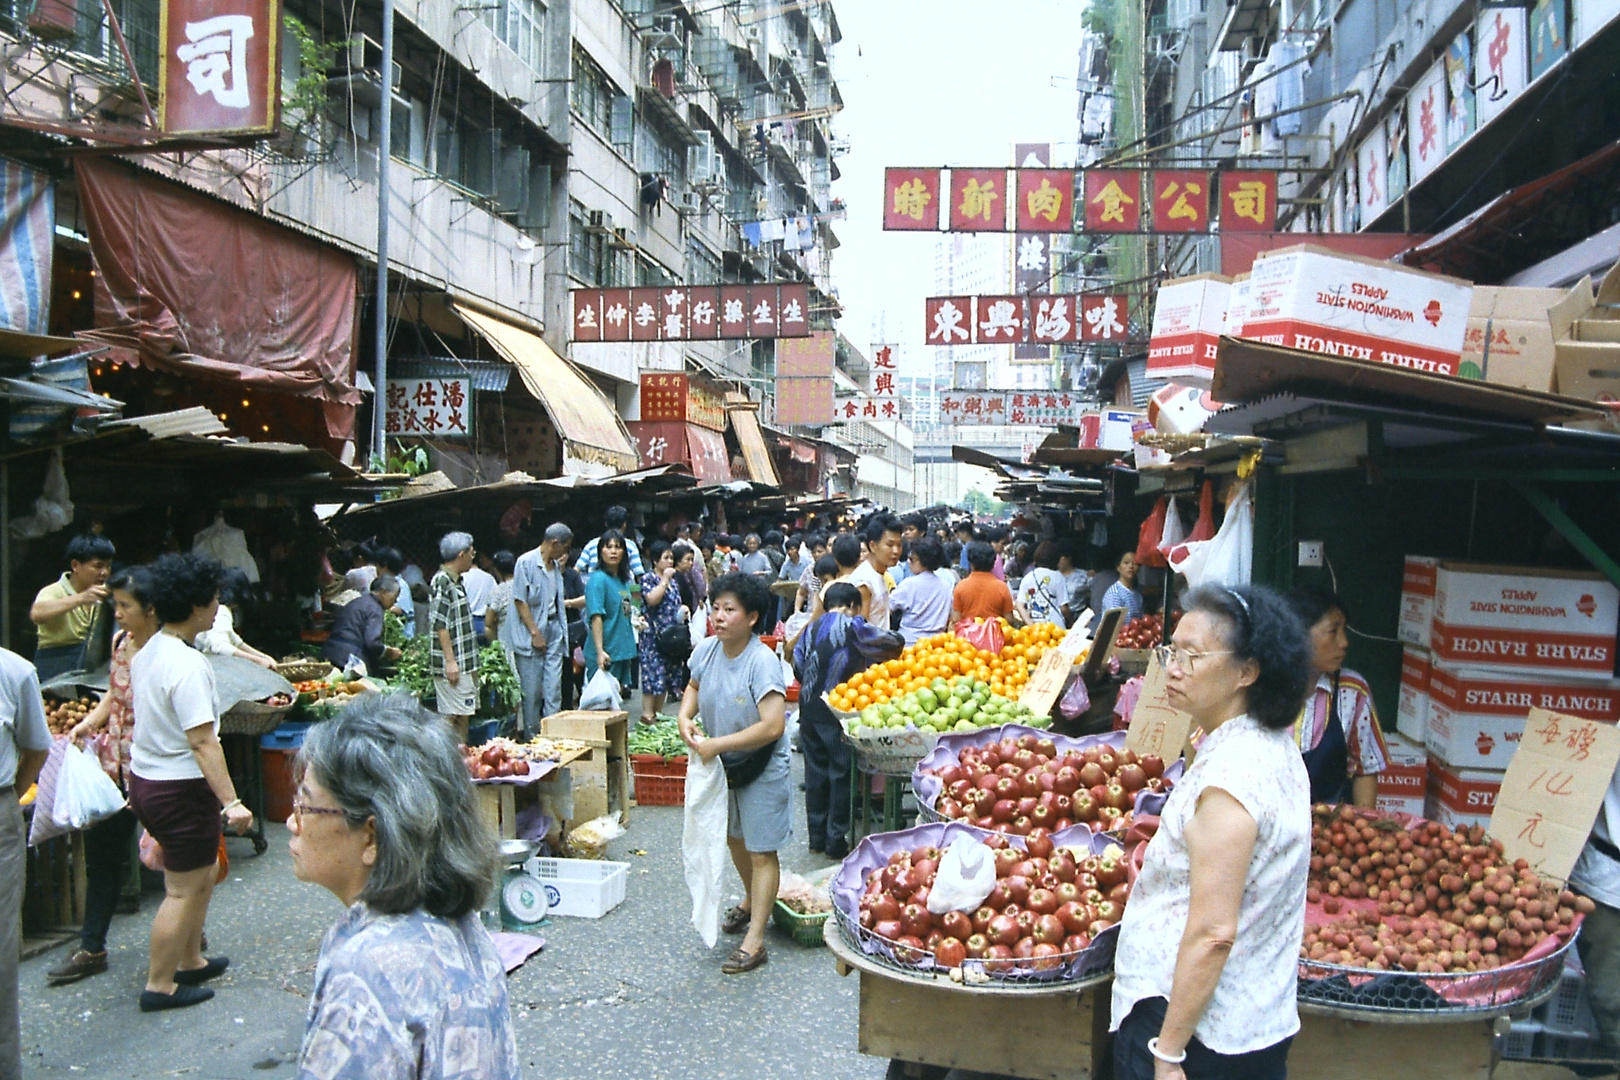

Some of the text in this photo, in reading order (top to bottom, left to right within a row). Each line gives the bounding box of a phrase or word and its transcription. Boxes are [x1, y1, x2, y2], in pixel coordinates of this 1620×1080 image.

[176, 14, 255, 108] 司
[893, 176, 1267, 225] 時新肉食公司
[1351, 282, 1389, 300] APPLES
[929, 297, 1125, 342] 東興海味
[1347, 297, 1416, 324] WASHINGTON
[874, 345, 897, 395] 建興
[1501, 588, 1538, 601] APPLES
[1469, 600, 1567, 618] WASHINGTON STATE
[1451, 636, 1608, 662] STARR RANCH
[1465, 689, 1612, 712] STARR RANCH
[1377, 775, 1421, 786] RANCH
